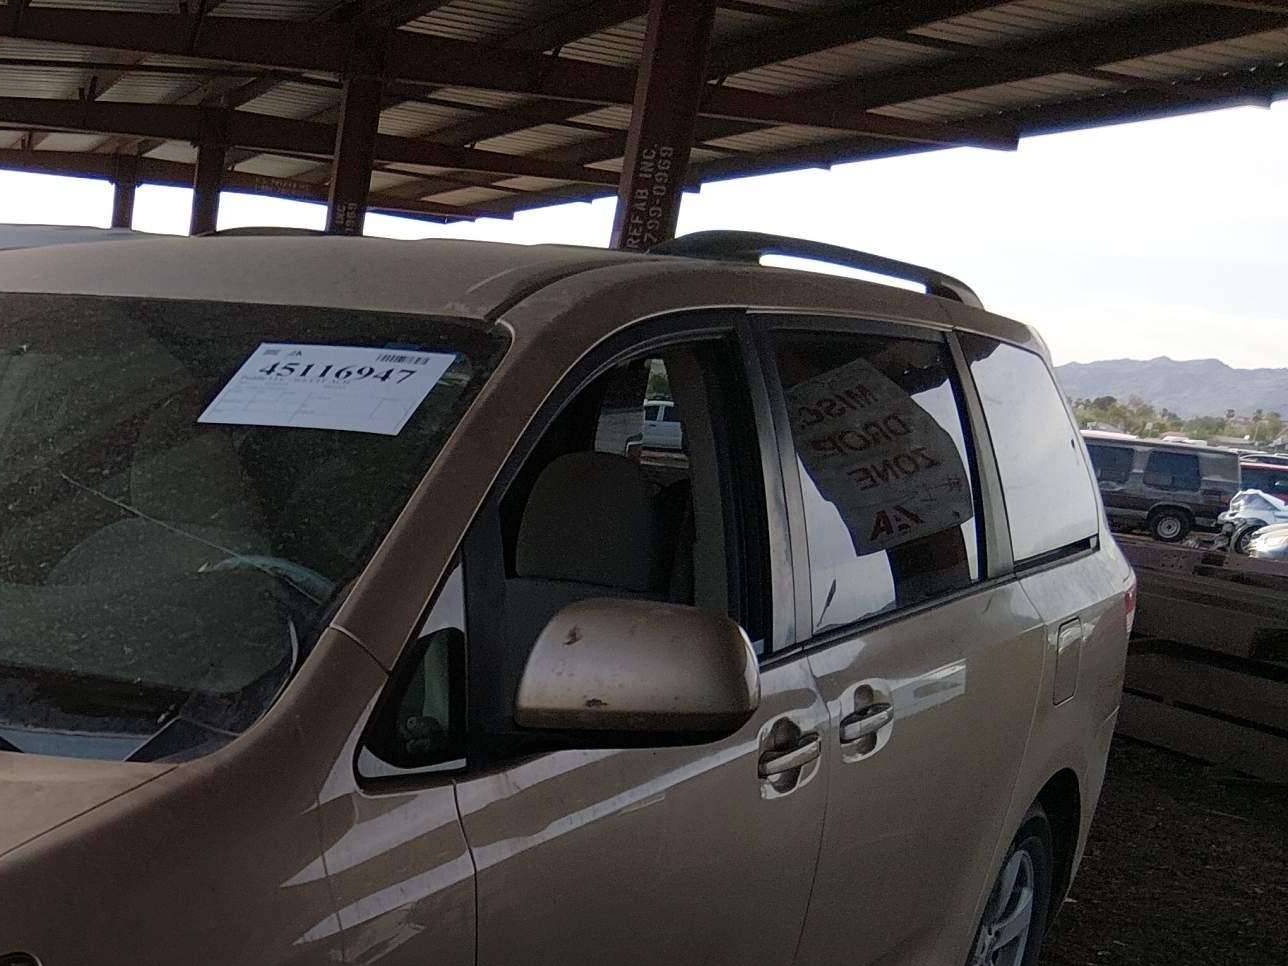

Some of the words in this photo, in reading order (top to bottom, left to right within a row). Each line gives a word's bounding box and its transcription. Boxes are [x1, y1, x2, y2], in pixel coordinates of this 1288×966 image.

[626, 188, 649, 248] REFAB
[639, 144, 658, 178] INC.
[259, 361, 417, 385] 45116947
